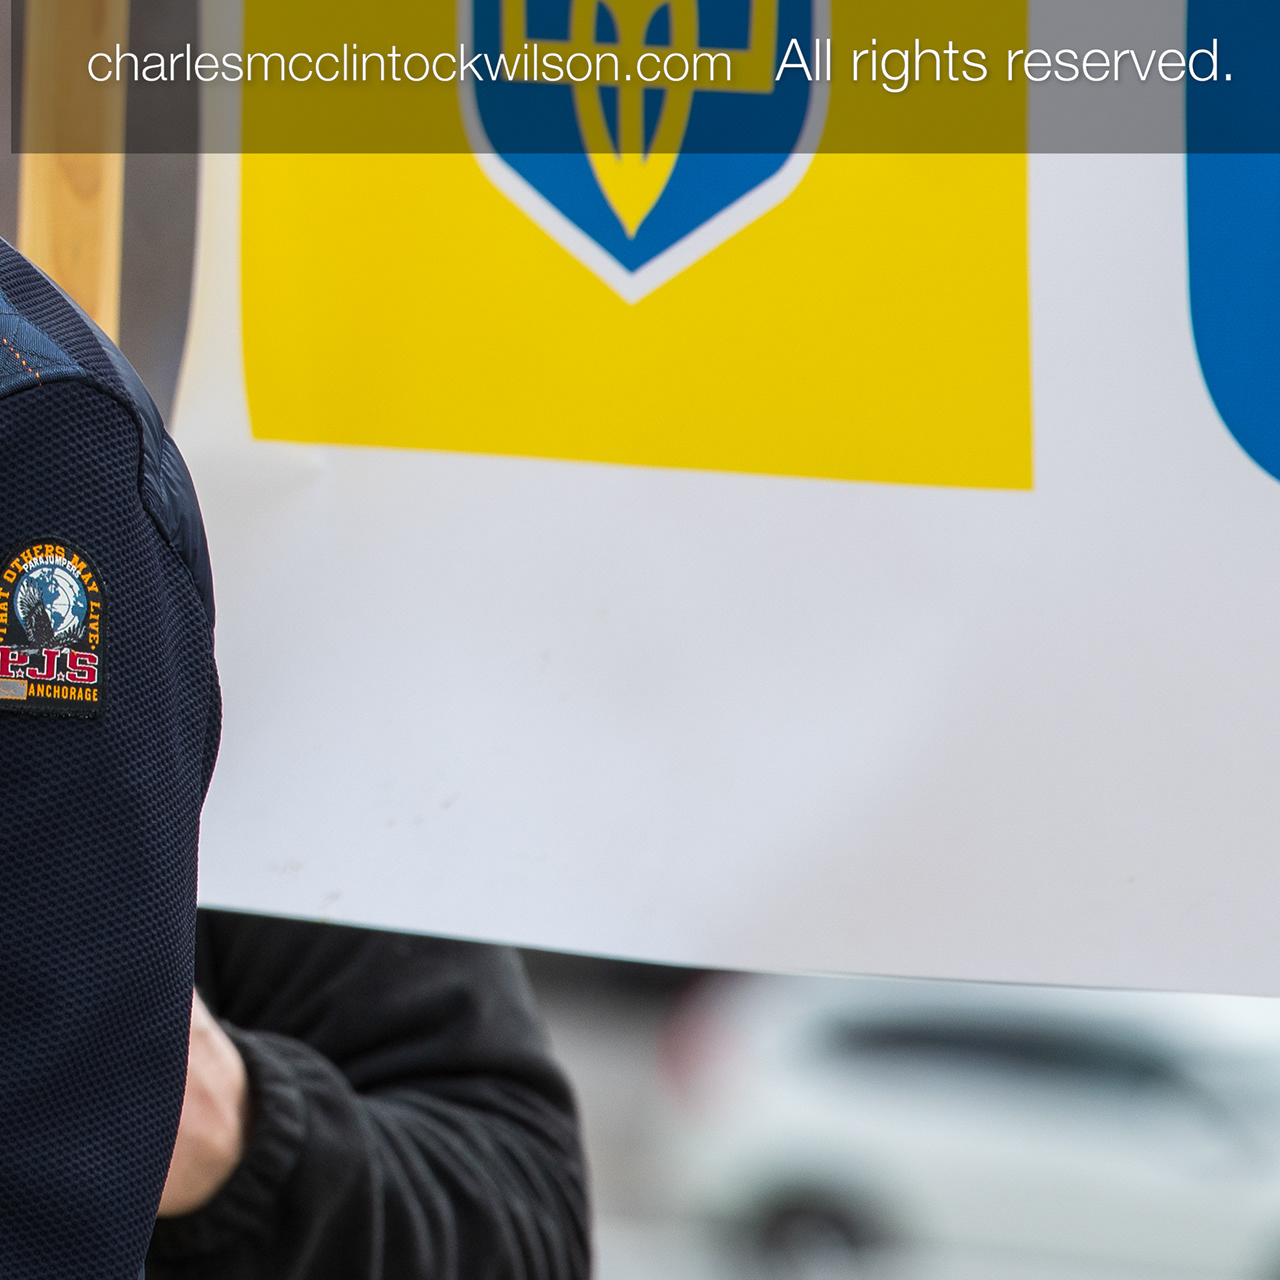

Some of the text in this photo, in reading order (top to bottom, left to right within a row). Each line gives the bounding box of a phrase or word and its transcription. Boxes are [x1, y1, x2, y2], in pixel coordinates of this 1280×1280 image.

[22, 555, 82, 579] PARAJUMPERS
[3, 544, 66, 584] OTHERS
[70, 553, 99, 594] MAY
[88, 600, 101, 645] LIVE
[28, 683, 99, 702] ANCHORAGE
